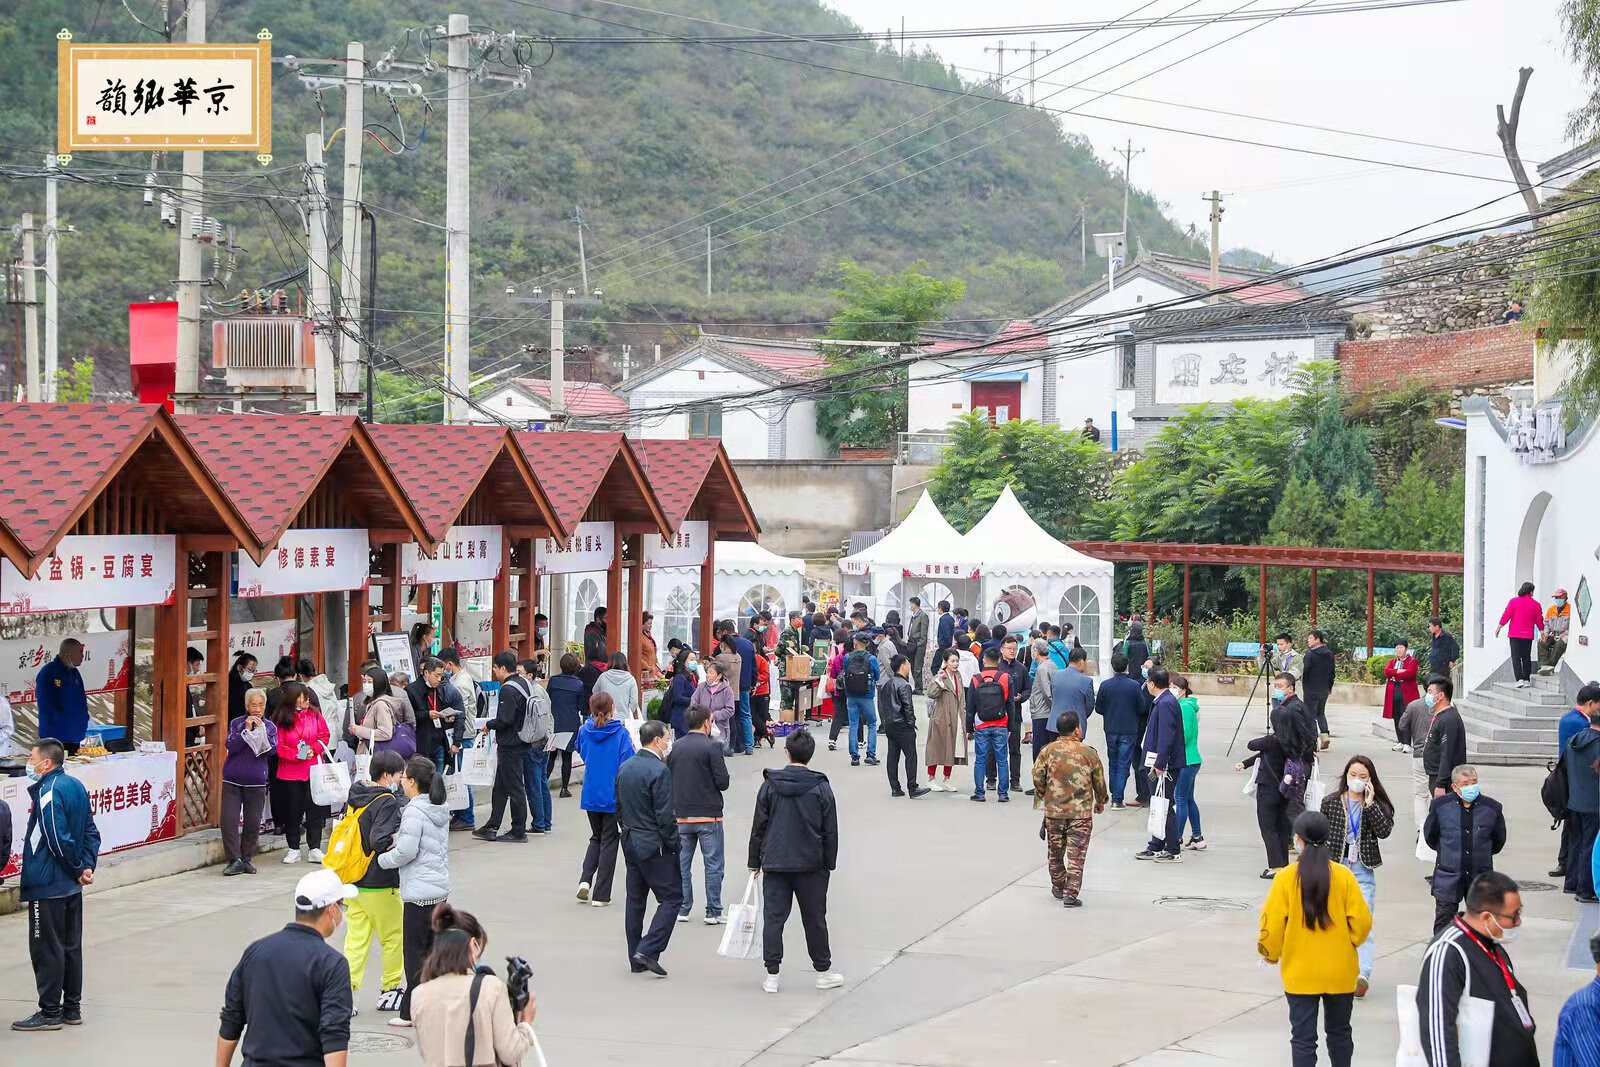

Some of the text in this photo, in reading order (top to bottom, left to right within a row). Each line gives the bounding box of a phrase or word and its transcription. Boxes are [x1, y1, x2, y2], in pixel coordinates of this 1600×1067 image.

[34, 553, 153, 582] 盆锅-豆腐宴
[278, 545, 335, 570] 修德素宴
